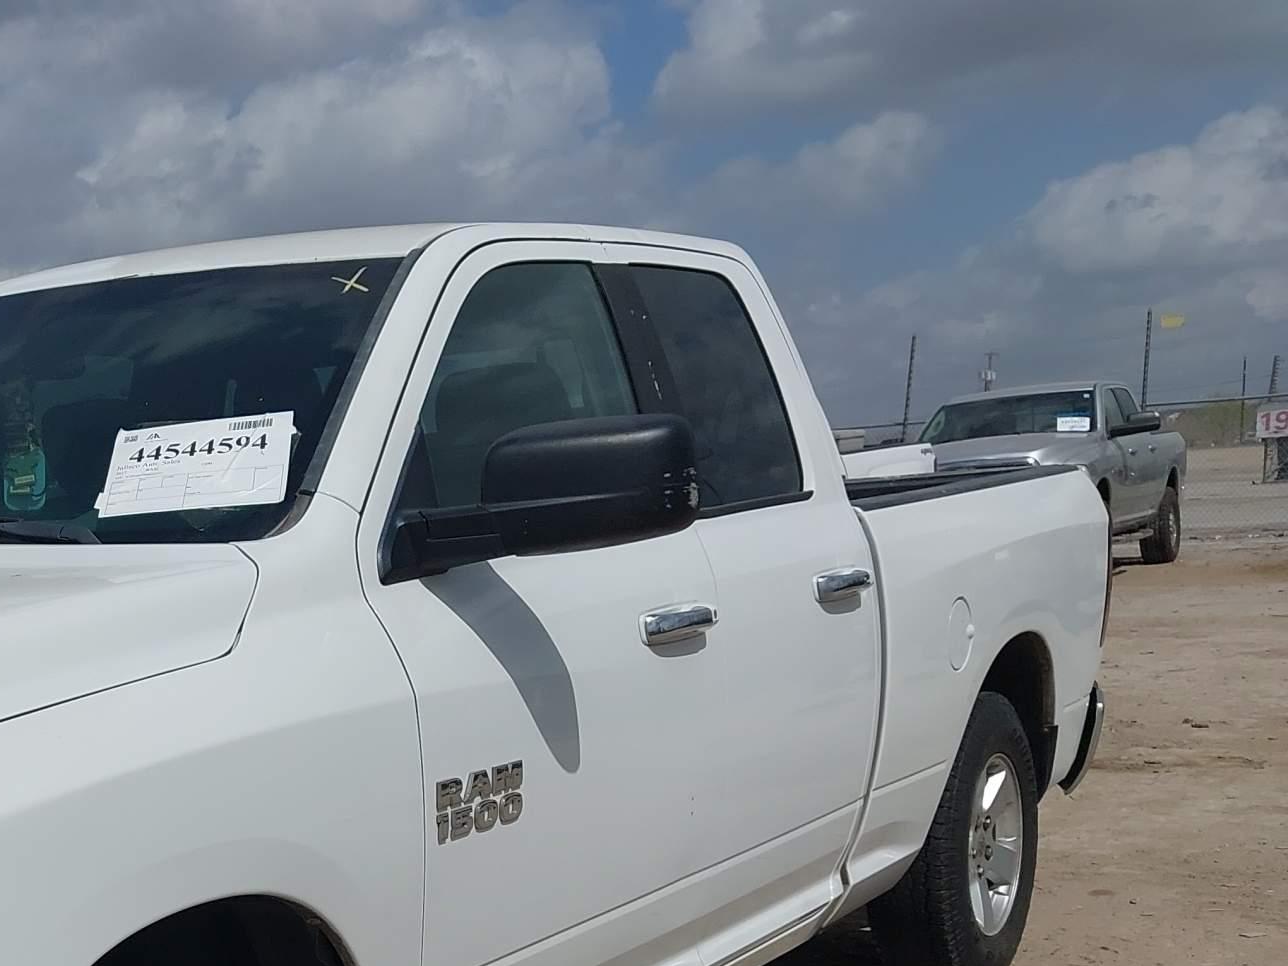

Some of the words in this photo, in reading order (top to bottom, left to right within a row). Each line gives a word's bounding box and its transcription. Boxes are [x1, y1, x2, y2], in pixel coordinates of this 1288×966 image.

[129, 433, 268, 462] 44544594
[436, 759, 524, 813] RAM
[436, 791, 524, 846] 1500
